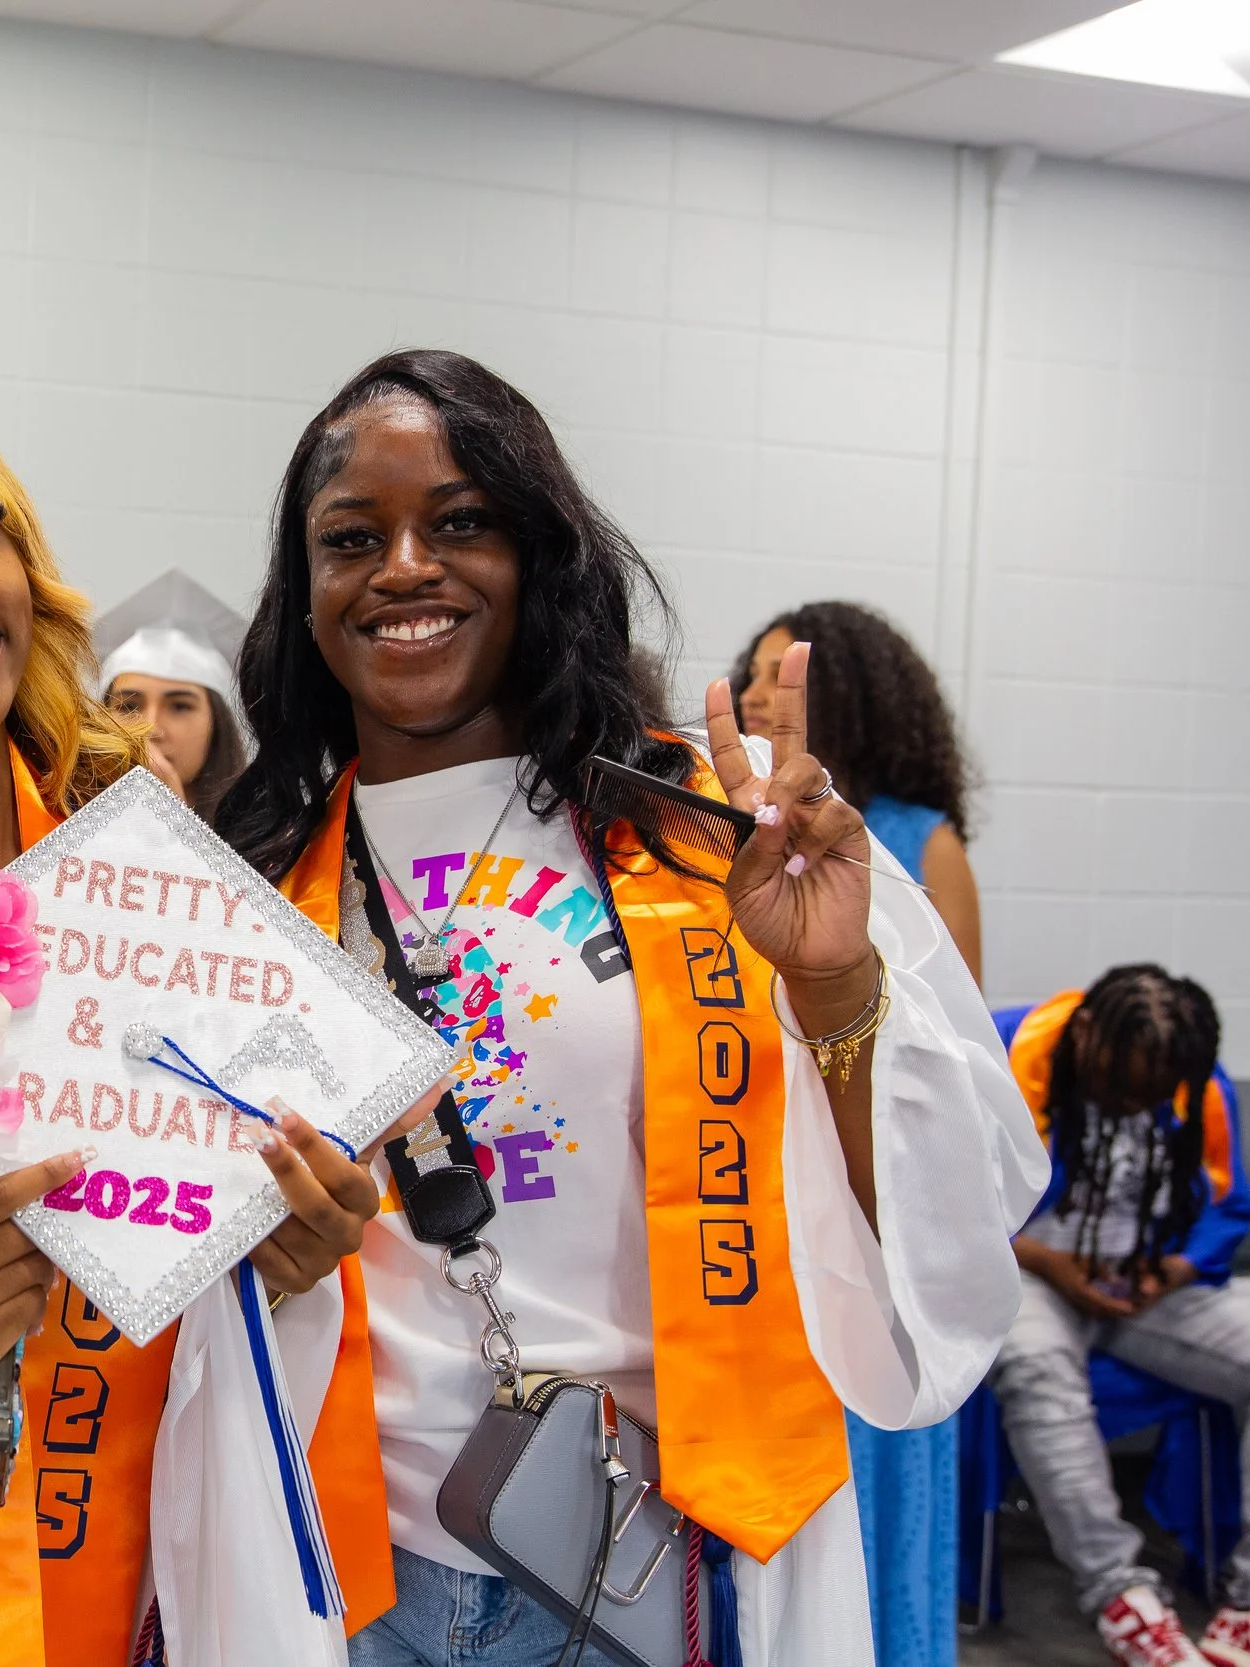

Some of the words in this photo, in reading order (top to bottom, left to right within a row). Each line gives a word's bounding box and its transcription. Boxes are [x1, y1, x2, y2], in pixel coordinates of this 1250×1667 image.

[53, 855, 265, 933] PRETTY.
[67, 996, 104, 1049] &
[17, 1070, 254, 1153] RADUATE
[679, 926, 758, 1306] 2025
[43, 1167, 214, 1235] 2025
